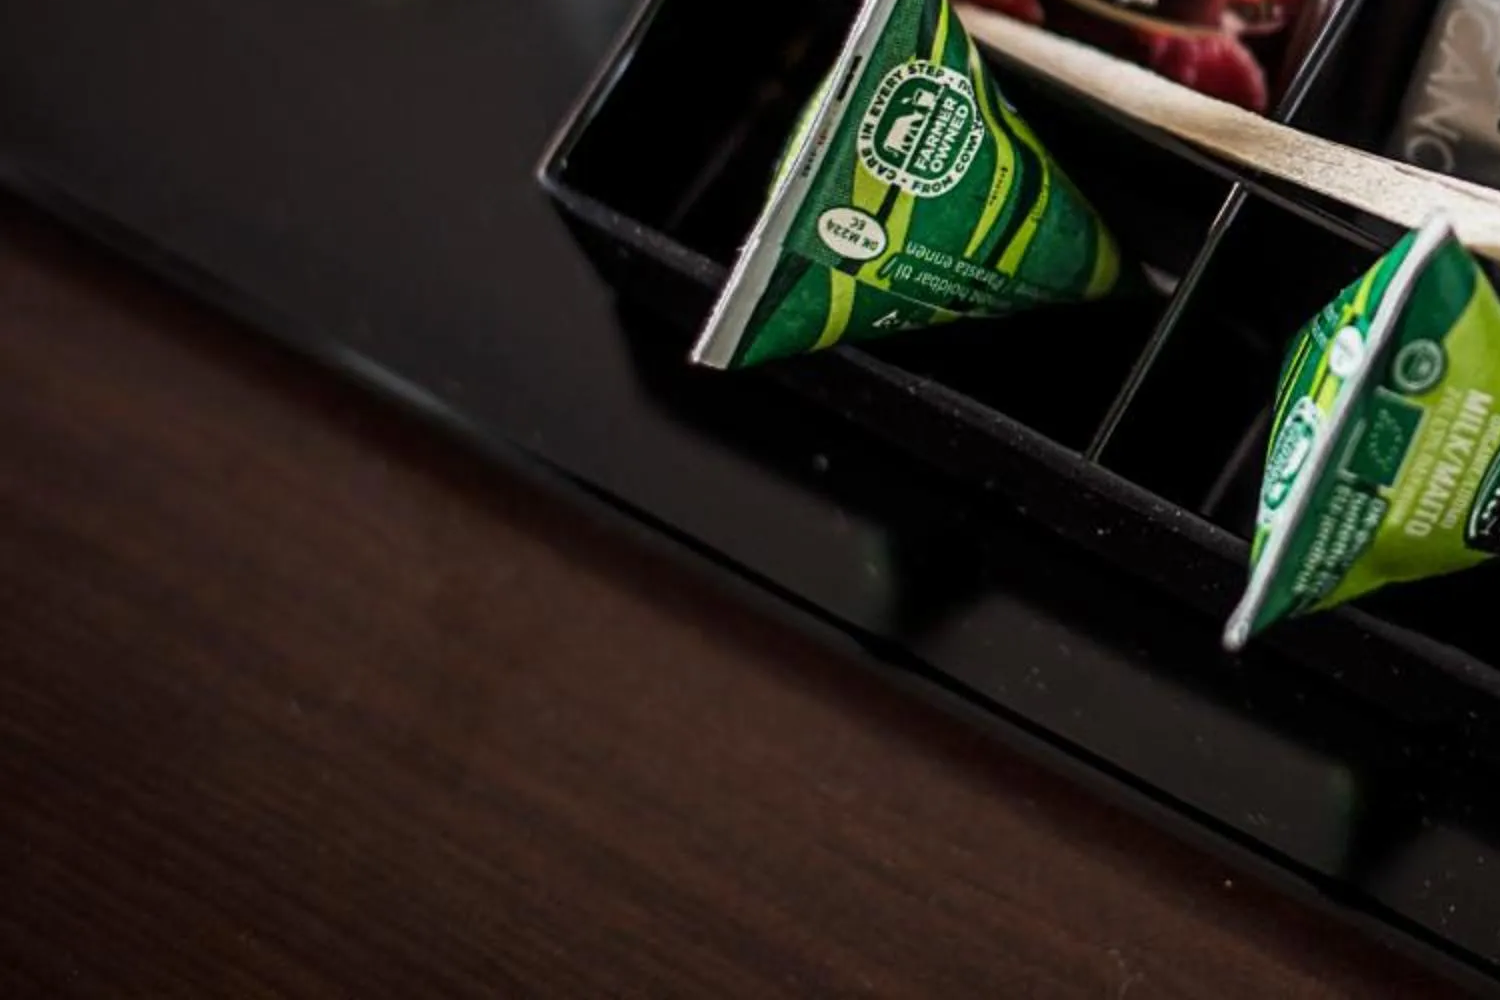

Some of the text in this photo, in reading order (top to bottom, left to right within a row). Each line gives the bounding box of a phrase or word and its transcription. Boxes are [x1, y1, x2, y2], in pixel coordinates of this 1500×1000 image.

[860, 63, 945, 181] CARE IN EVERY STEP
[914, 95, 959, 170] FARMER
[929, 103, 969, 174] OWNED
[911, 176, 953, 194] FROM
[904, 240, 954, 269] ennen
[1403, 388, 1494, 539] MILK/MAITO
